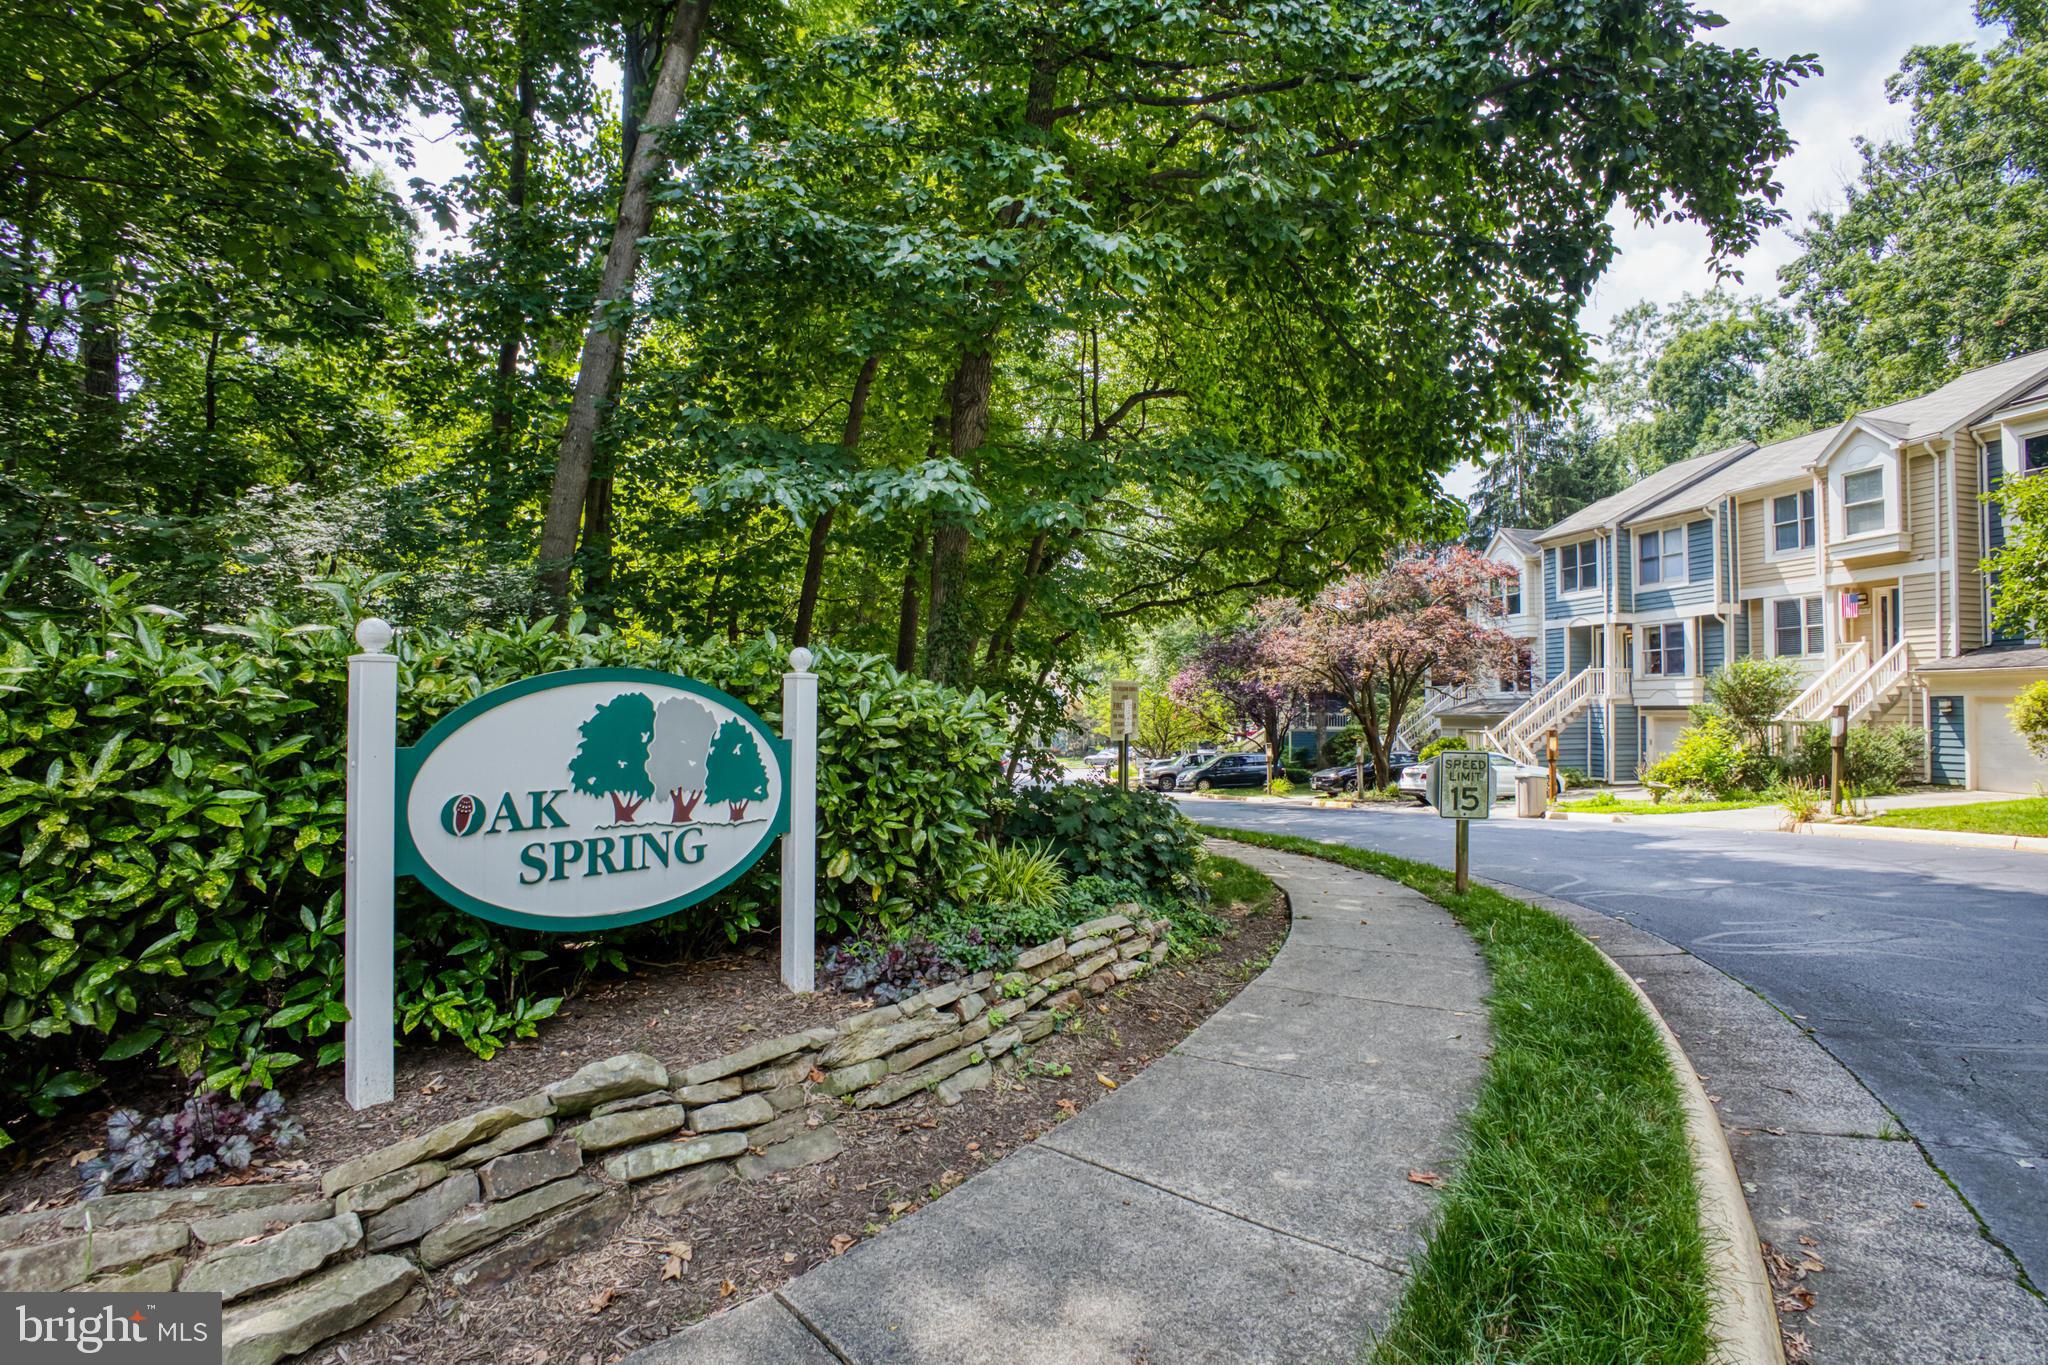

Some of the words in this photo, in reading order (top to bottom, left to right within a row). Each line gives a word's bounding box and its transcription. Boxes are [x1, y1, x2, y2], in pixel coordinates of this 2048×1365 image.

[1445, 759, 1486, 770] SPEED
[1449, 772, 1482, 782] LIMIT
[1450, 786, 1480, 812] 15
[440, 788, 571, 838] OAK
[518, 827, 708, 885] SPRING
